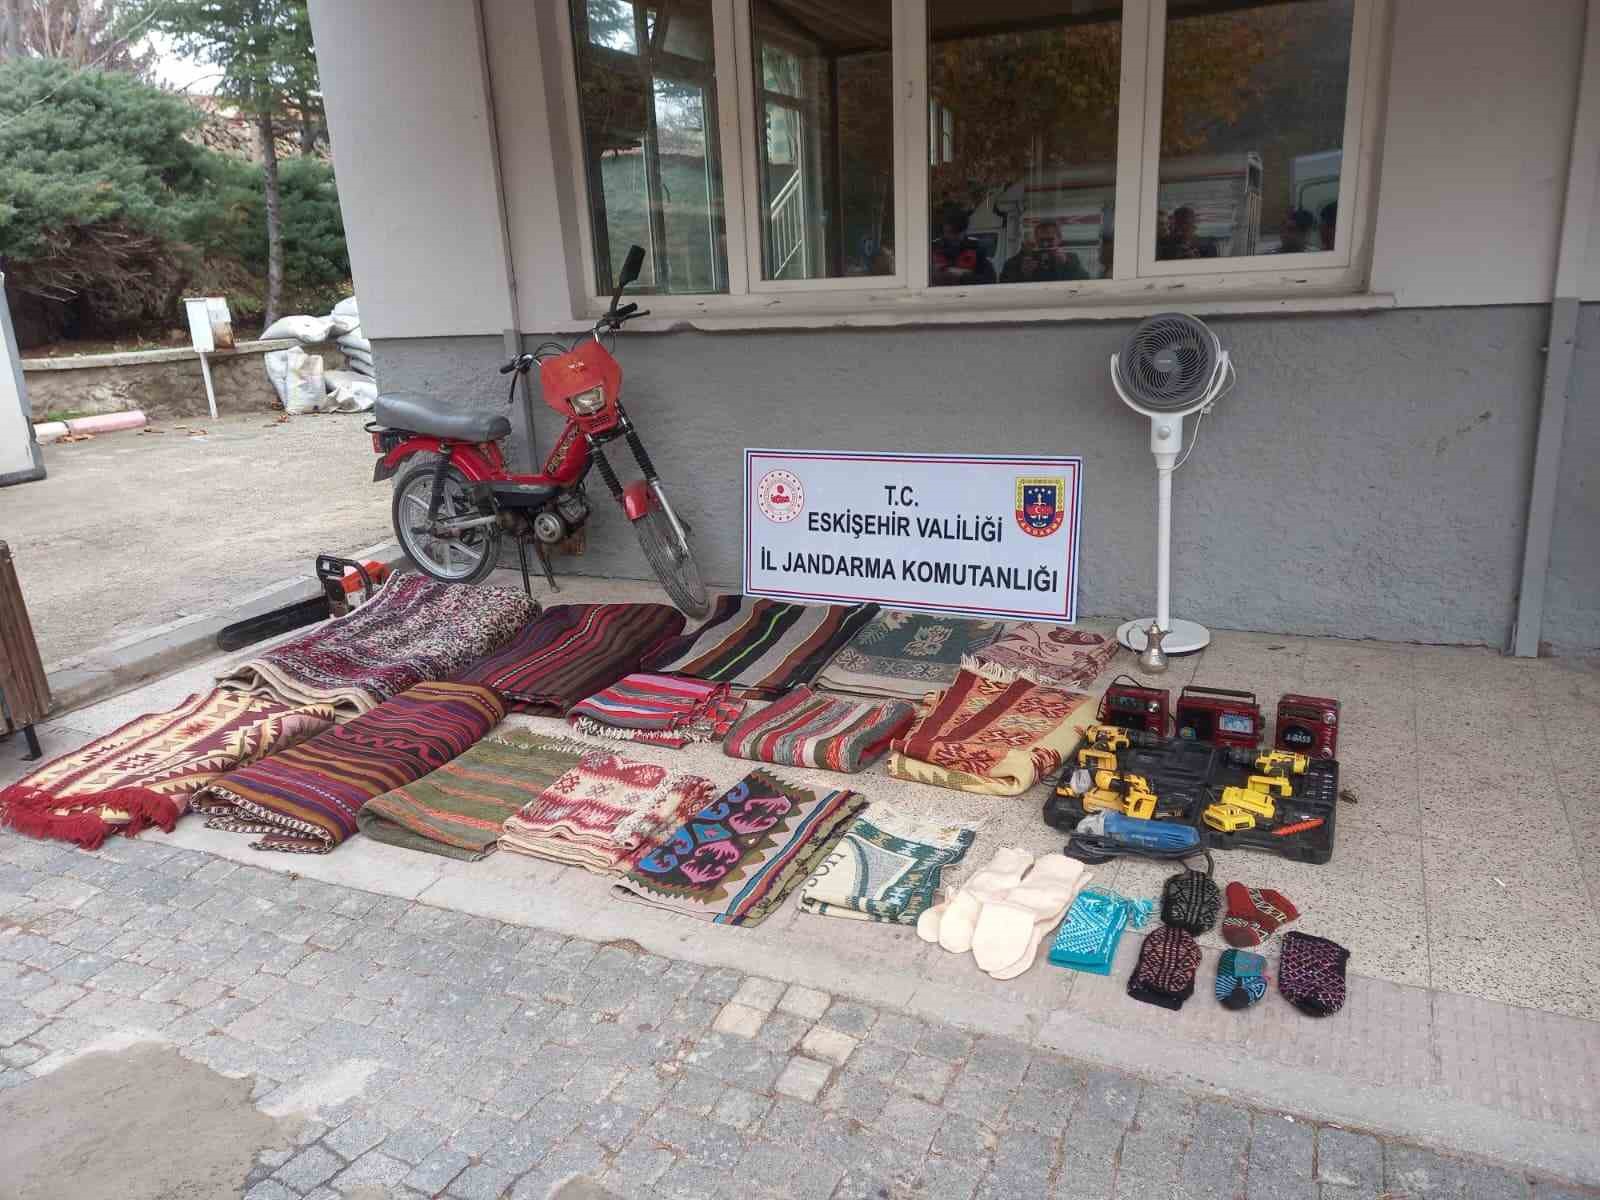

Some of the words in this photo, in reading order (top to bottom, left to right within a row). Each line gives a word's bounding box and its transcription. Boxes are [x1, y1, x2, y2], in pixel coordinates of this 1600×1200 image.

[884, 485, 919, 507] T.C.
[808, 508, 910, 539] ESKİŞEHİR
[917, 514, 1003, 543] VALİLİĞİ
[761, 546, 777, 571] İL
[782, 551, 896, 580] JANDARMA
[902, 559, 1058, 593] KOMUTANLIĞI
